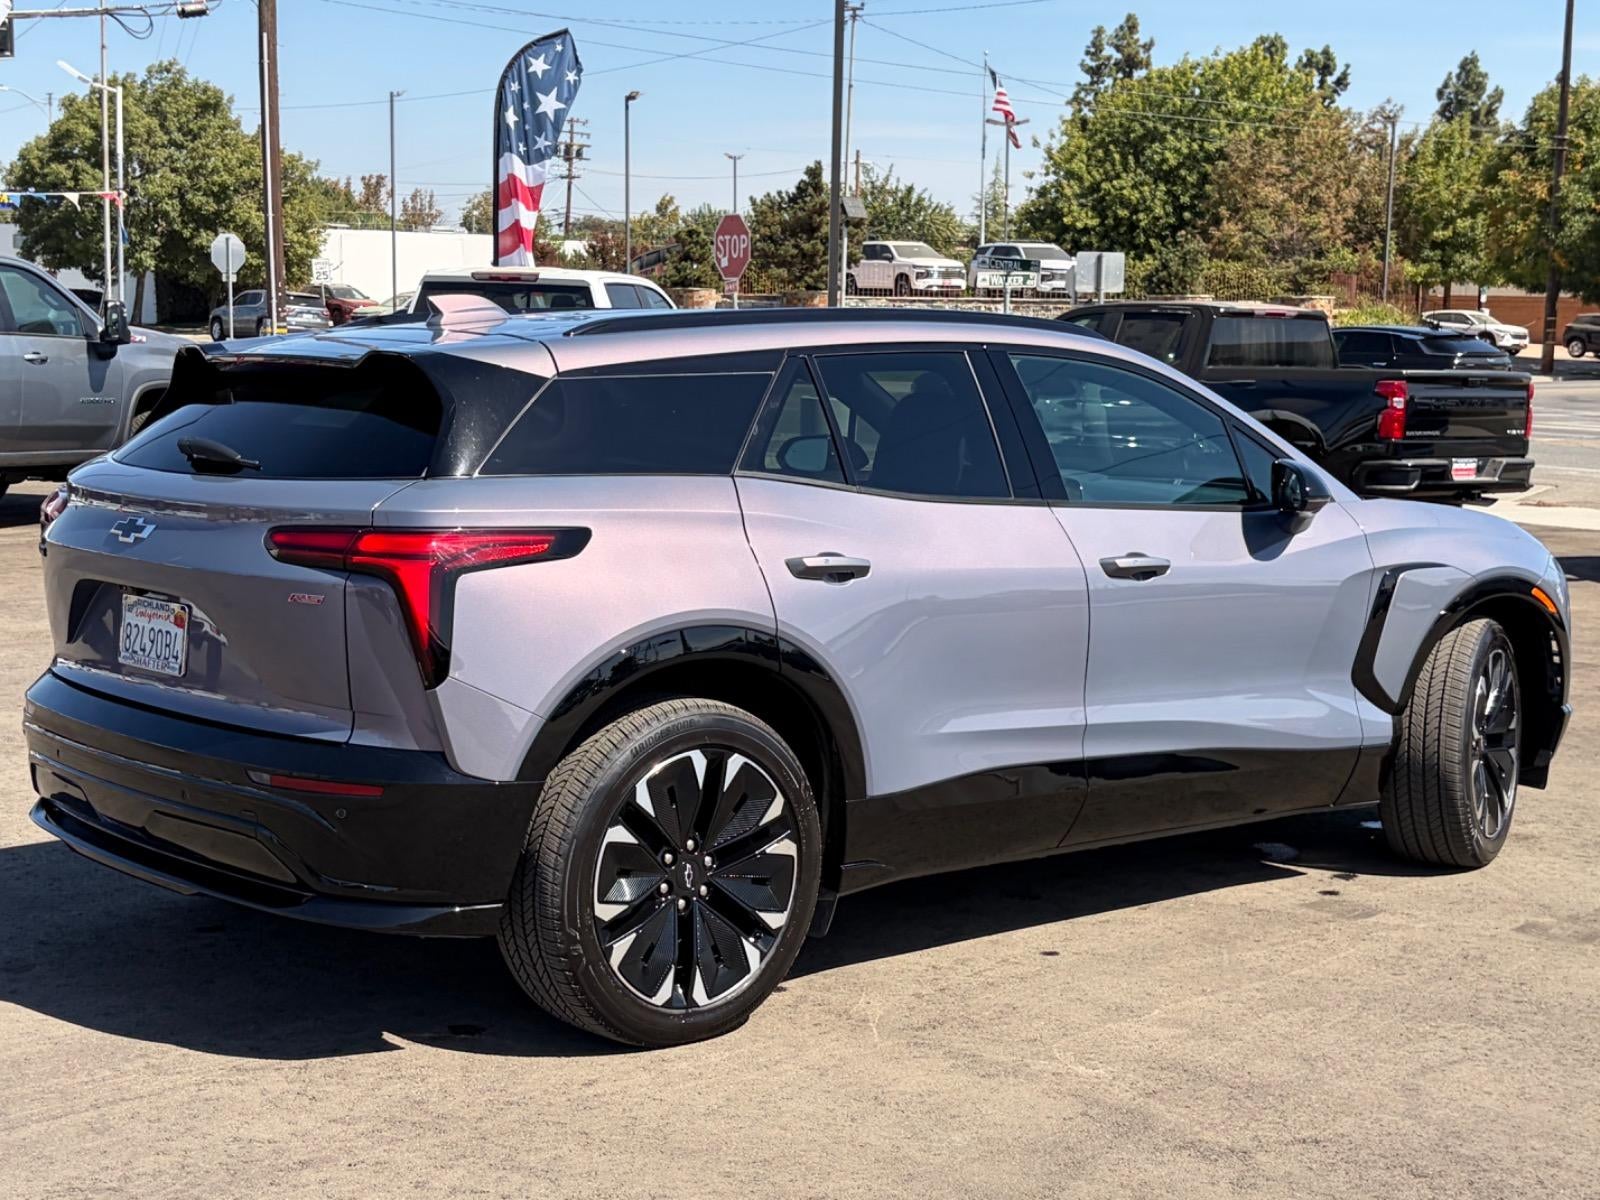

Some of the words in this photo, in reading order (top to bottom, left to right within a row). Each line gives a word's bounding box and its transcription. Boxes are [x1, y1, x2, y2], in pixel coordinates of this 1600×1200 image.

[717, 234, 748, 258] STOP
[989, 259, 1022, 271] CENTRAL
[315, 271, 329, 280] 25
[990, 274, 1023, 286] WALKER
[124, 622, 180, 662] 82490B4
